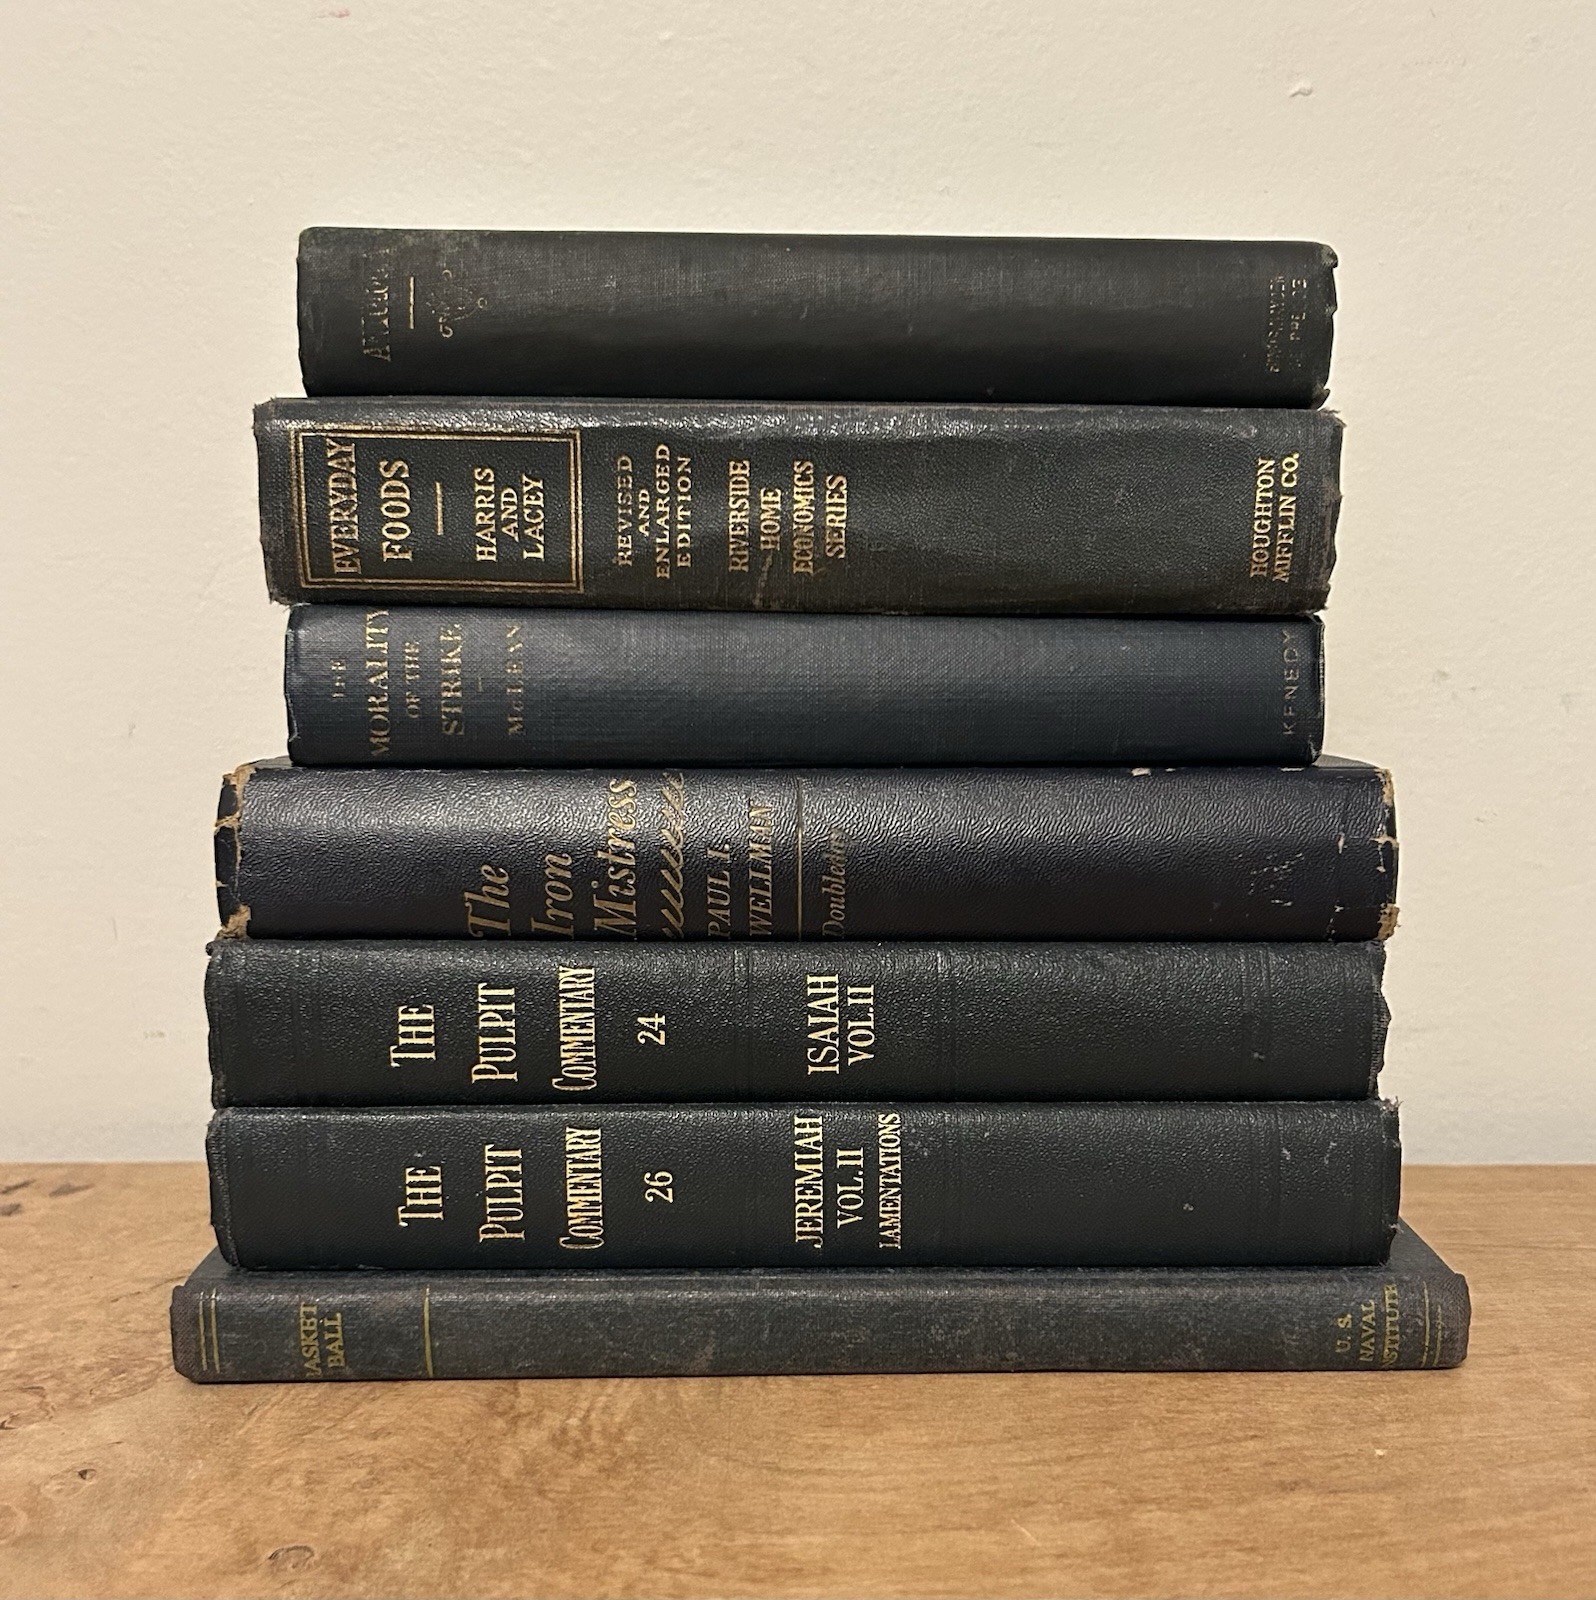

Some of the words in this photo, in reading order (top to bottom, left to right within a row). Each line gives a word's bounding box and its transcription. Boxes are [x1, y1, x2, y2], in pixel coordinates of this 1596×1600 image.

[326, 438, 362, 574] EVERYDAY
[379, 460, 413, 561] FOODS
[616, 454, 633, 566] REVISED
[638, 489, 650, 537] AND
[656, 443, 671, 578] ENLARGED
[676, 456, 692, 567] EDITION
[1280, 453, 1299, 487] CO.
[474, 468, 496, 561] HARRIS
[500, 487, 519, 541] AND
[522, 474, 545, 560] LACEY
[728, 460, 750, 572] RIVERSIDE
[760, 488, 782, 551] HOME
[792, 461, 815, 574] ECONOMICS
[825, 475, 847, 558] SERIES
[1250, 457, 1275, 577] HOUGHTON
[1272, 494, 1297, 582] MIFFLIN
[405, 641, 420, 684] THE
[406, 692, 421, 718] OF
[440, 623, 465, 735] STRIKE
[464, 864, 511, 937] The
[531, 853, 574, 939] Iron
[591, 778, 637, 937] Mistress
[748, 799, 772, 935] WELLMAN
[707, 871, 730, 939] PAUL
[637, 1012, 666, 1046] 24
[807, 973, 839, 1075] ISAIAH
[644, 1171, 673, 1203] 26
[794, 1114, 823, 1248] JEREMIAH
[878, 1113, 902, 1249] LAMENTATIONS
[324, 1312, 345, 1367] BALL
[1335, 1313, 1352, 1329] S.
[1335, 1336, 1352, 1352] U.
[1359, 1300, 1376, 1362] NAVAL
